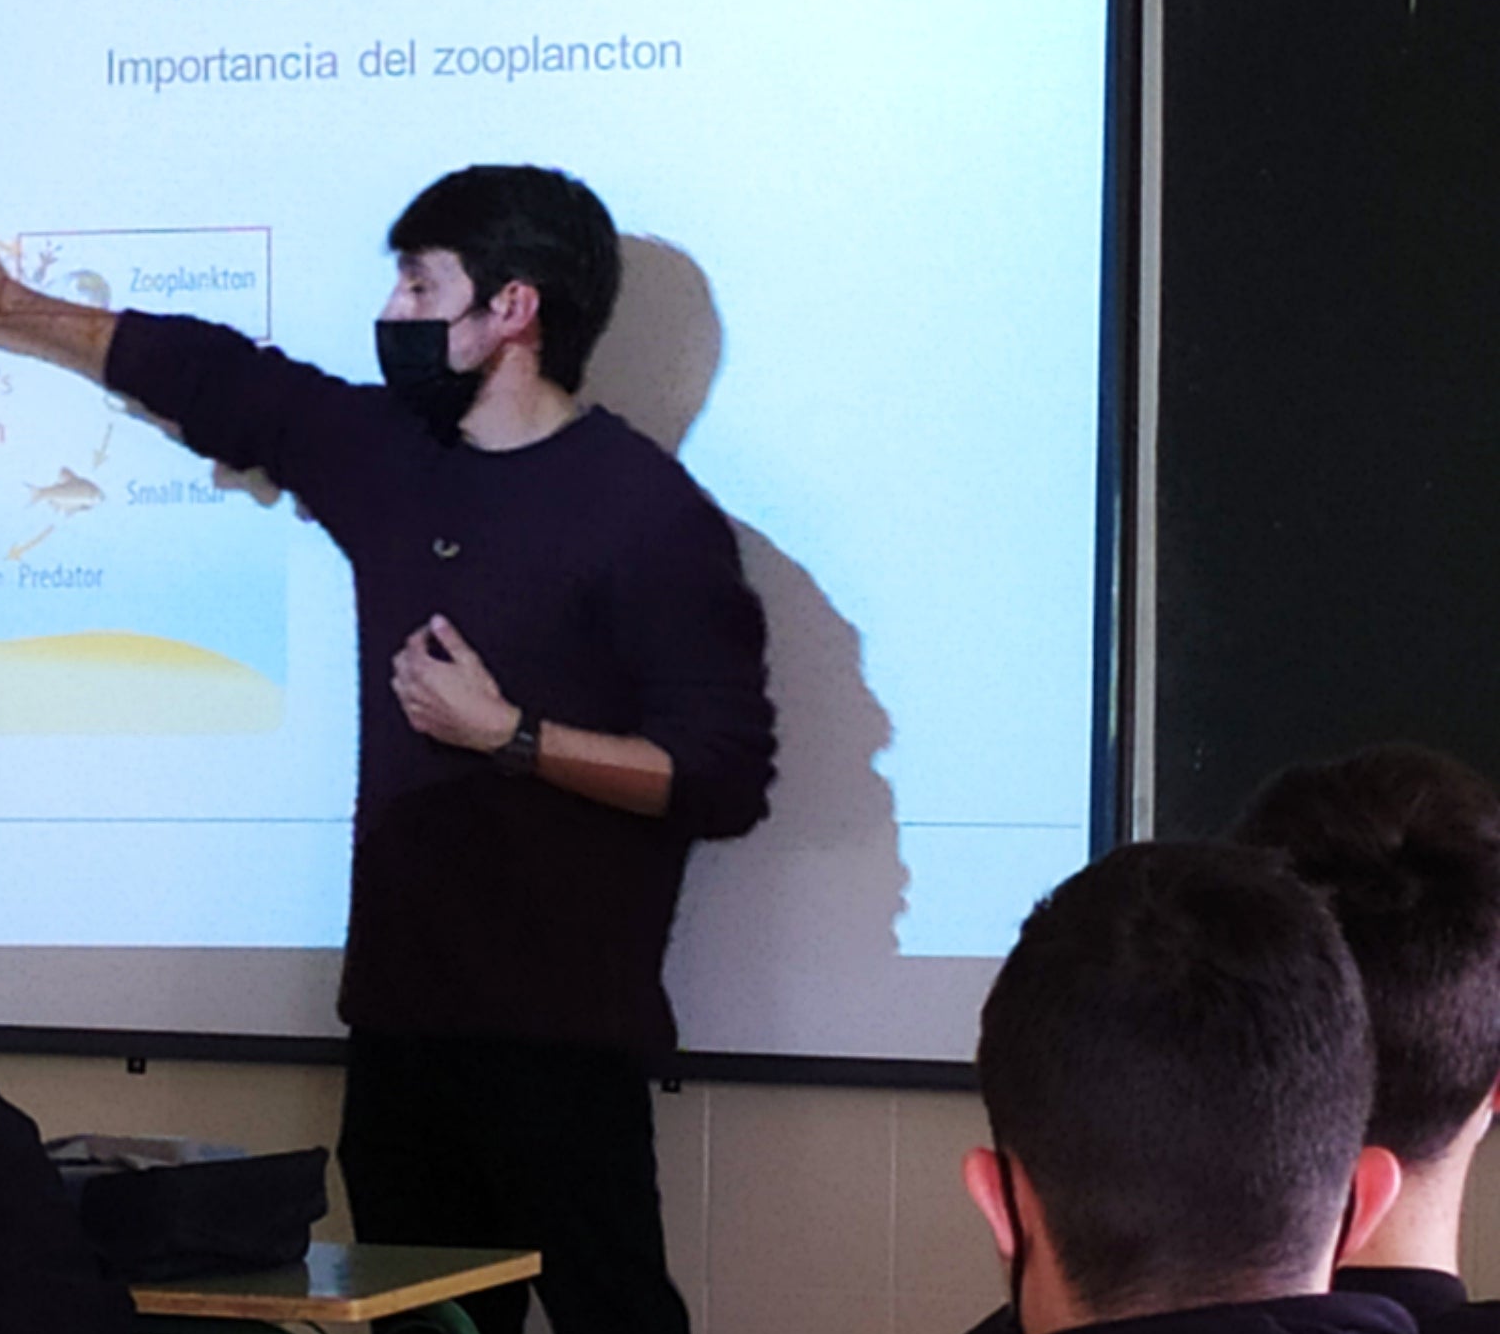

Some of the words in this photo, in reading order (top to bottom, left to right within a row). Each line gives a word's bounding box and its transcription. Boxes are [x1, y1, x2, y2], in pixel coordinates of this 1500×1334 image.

[106, 43, 339, 93] Importancia
[358, 40, 416, 77] del
[432, 34, 683, 82] zooplancton
[130, 267, 256, 298] Zooplankton
[126, 478, 183, 505] Small
[18, 564, 104, 589] Predator
